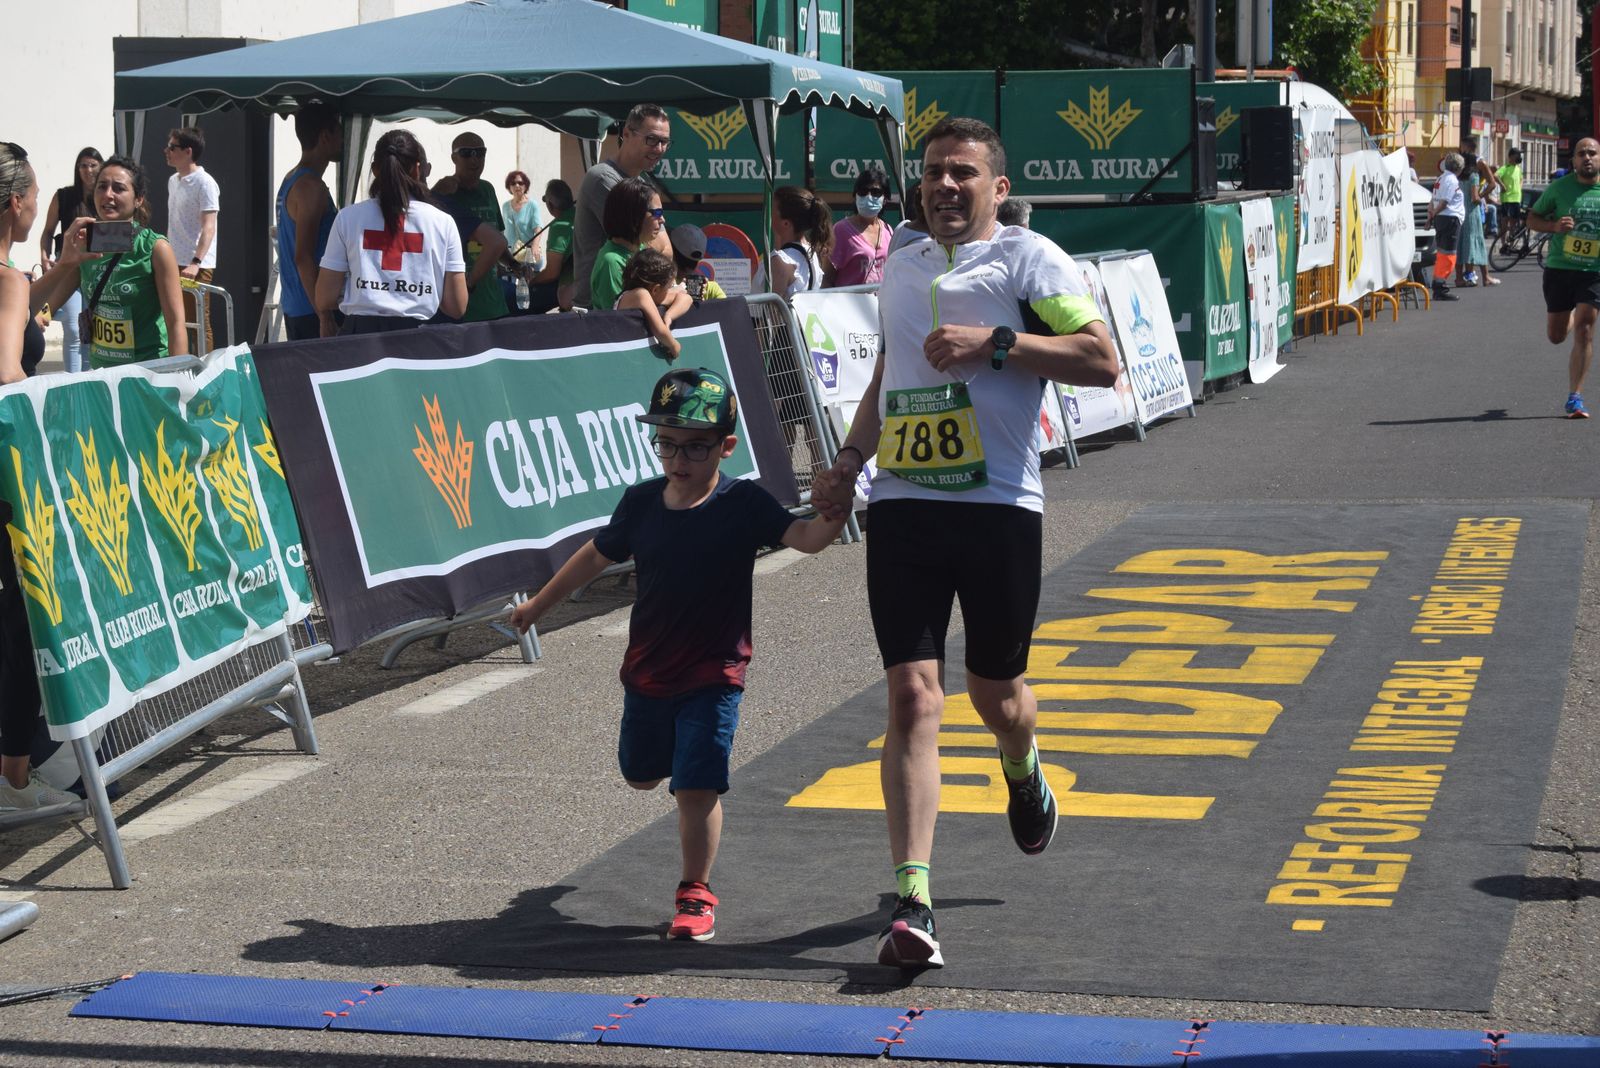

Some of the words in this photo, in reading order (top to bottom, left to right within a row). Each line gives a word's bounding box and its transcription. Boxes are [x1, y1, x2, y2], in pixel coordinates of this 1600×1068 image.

[655, 158, 701, 181] AJA
[1023, 159, 1084, 181] CAJA
[1091, 157, 1178, 180] RURAL
[1572, 239, 1592, 255] 93
[394, 279, 432, 297] Roja
[94, 317, 126, 345] 1065
[1131, 352, 1185, 402] OCEANIC
[927, 399, 958, 413] RURAL
[485, 412, 589, 510] CAJA
[576, 402, 667, 490] RUR
[894, 418, 965, 463] 188
[1434, 517, 1523, 580] INTERIORES
[105, 615, 134, 649] CAJA
[126, 601, 168, 638] RURAL
[1408, 584, 1505, 635] DISEÑO
[61, 631, 100, 671] URAL
[1349, 656, 1485, 753] INTEGRAL
[1265, 764, 1448, 908] REFORMA
